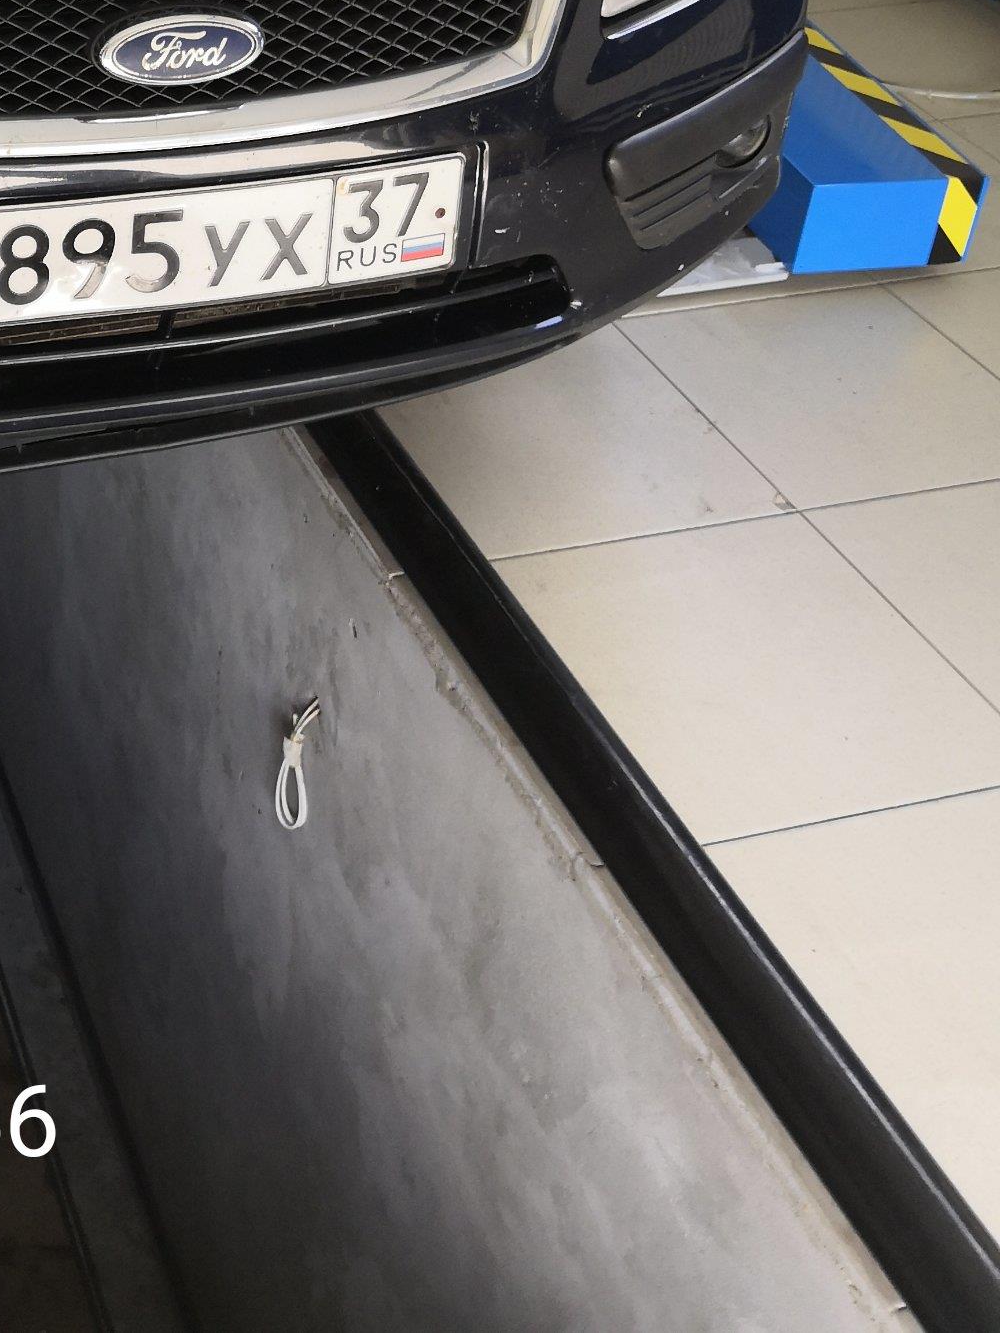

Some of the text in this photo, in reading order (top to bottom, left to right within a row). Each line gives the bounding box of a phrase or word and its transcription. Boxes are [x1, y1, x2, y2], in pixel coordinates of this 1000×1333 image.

[141, 30, 228, 73] Ford
[342, 172, 430, 244] 37
[335, 242, 398, 273] RUS
